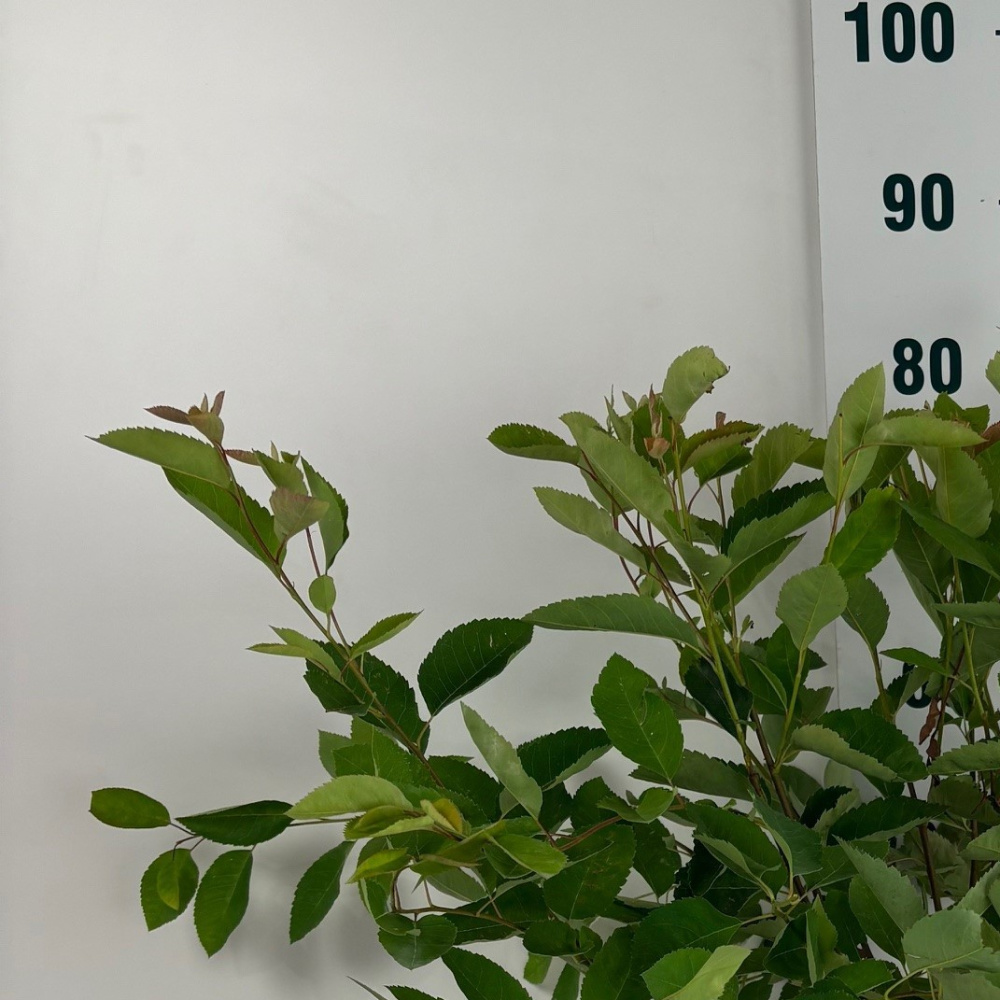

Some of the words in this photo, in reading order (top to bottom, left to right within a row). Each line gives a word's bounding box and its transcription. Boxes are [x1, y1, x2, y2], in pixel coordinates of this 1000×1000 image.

[844, 2, 954, 63] 100
[883, 173, 954, 232] 90
[893, 338, 962, 396] 80
